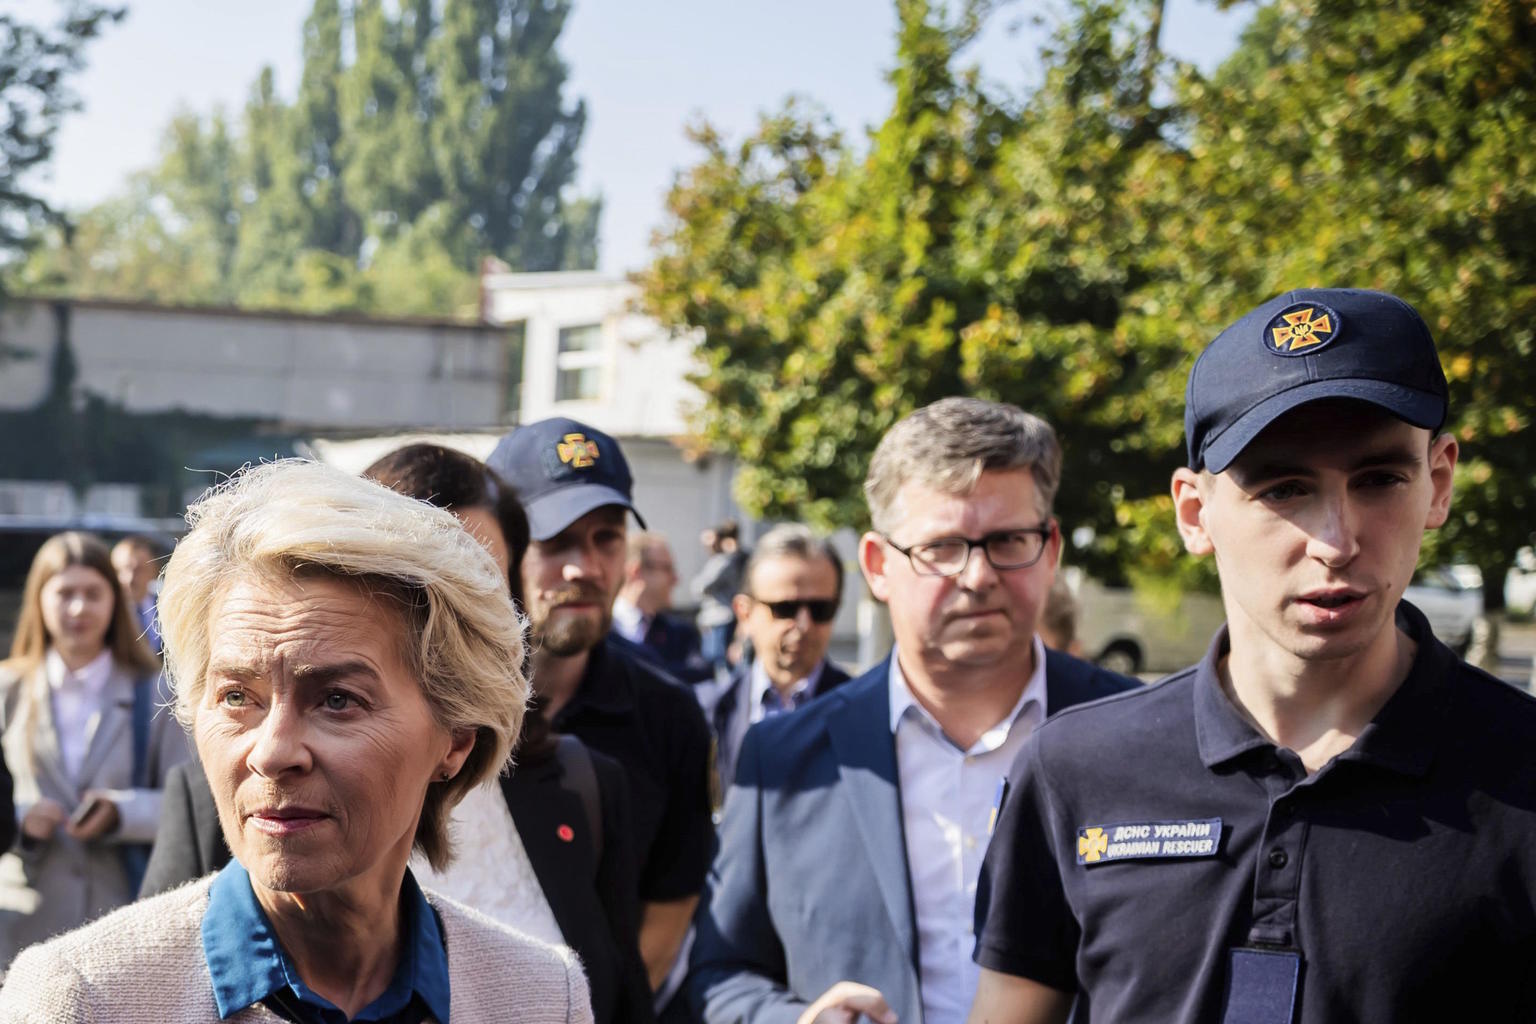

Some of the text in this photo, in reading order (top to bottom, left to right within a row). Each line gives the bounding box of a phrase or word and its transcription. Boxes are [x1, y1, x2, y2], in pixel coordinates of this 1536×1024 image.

[1114, 822, 1211, 842] ДСНС УКРАЇНИ
[1107, 839, 1214, 858] UKRAINIAN RESCUER
